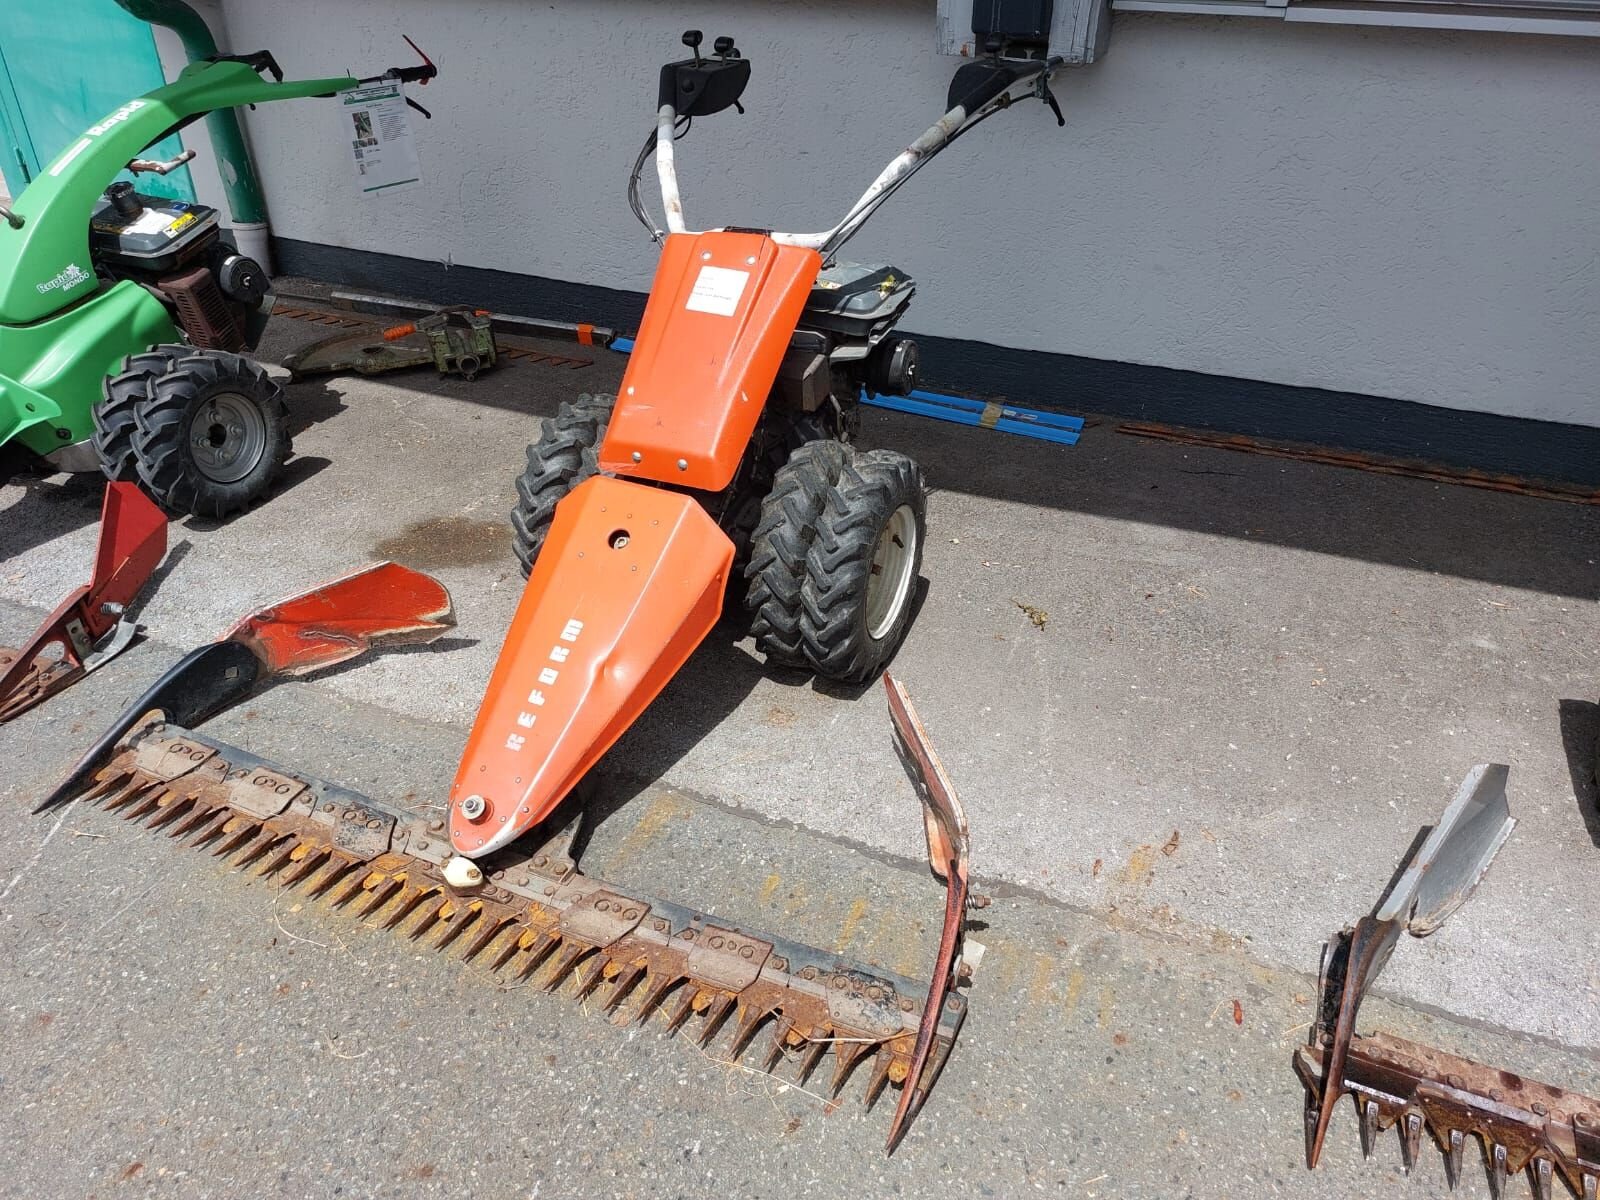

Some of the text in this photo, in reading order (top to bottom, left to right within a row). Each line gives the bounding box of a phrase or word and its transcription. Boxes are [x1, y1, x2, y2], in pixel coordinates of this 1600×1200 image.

[86, 101, 147, 136] Rapid
[62, 272, 90, 292] MONDO
[505, 619, 584, 751] REFORM
